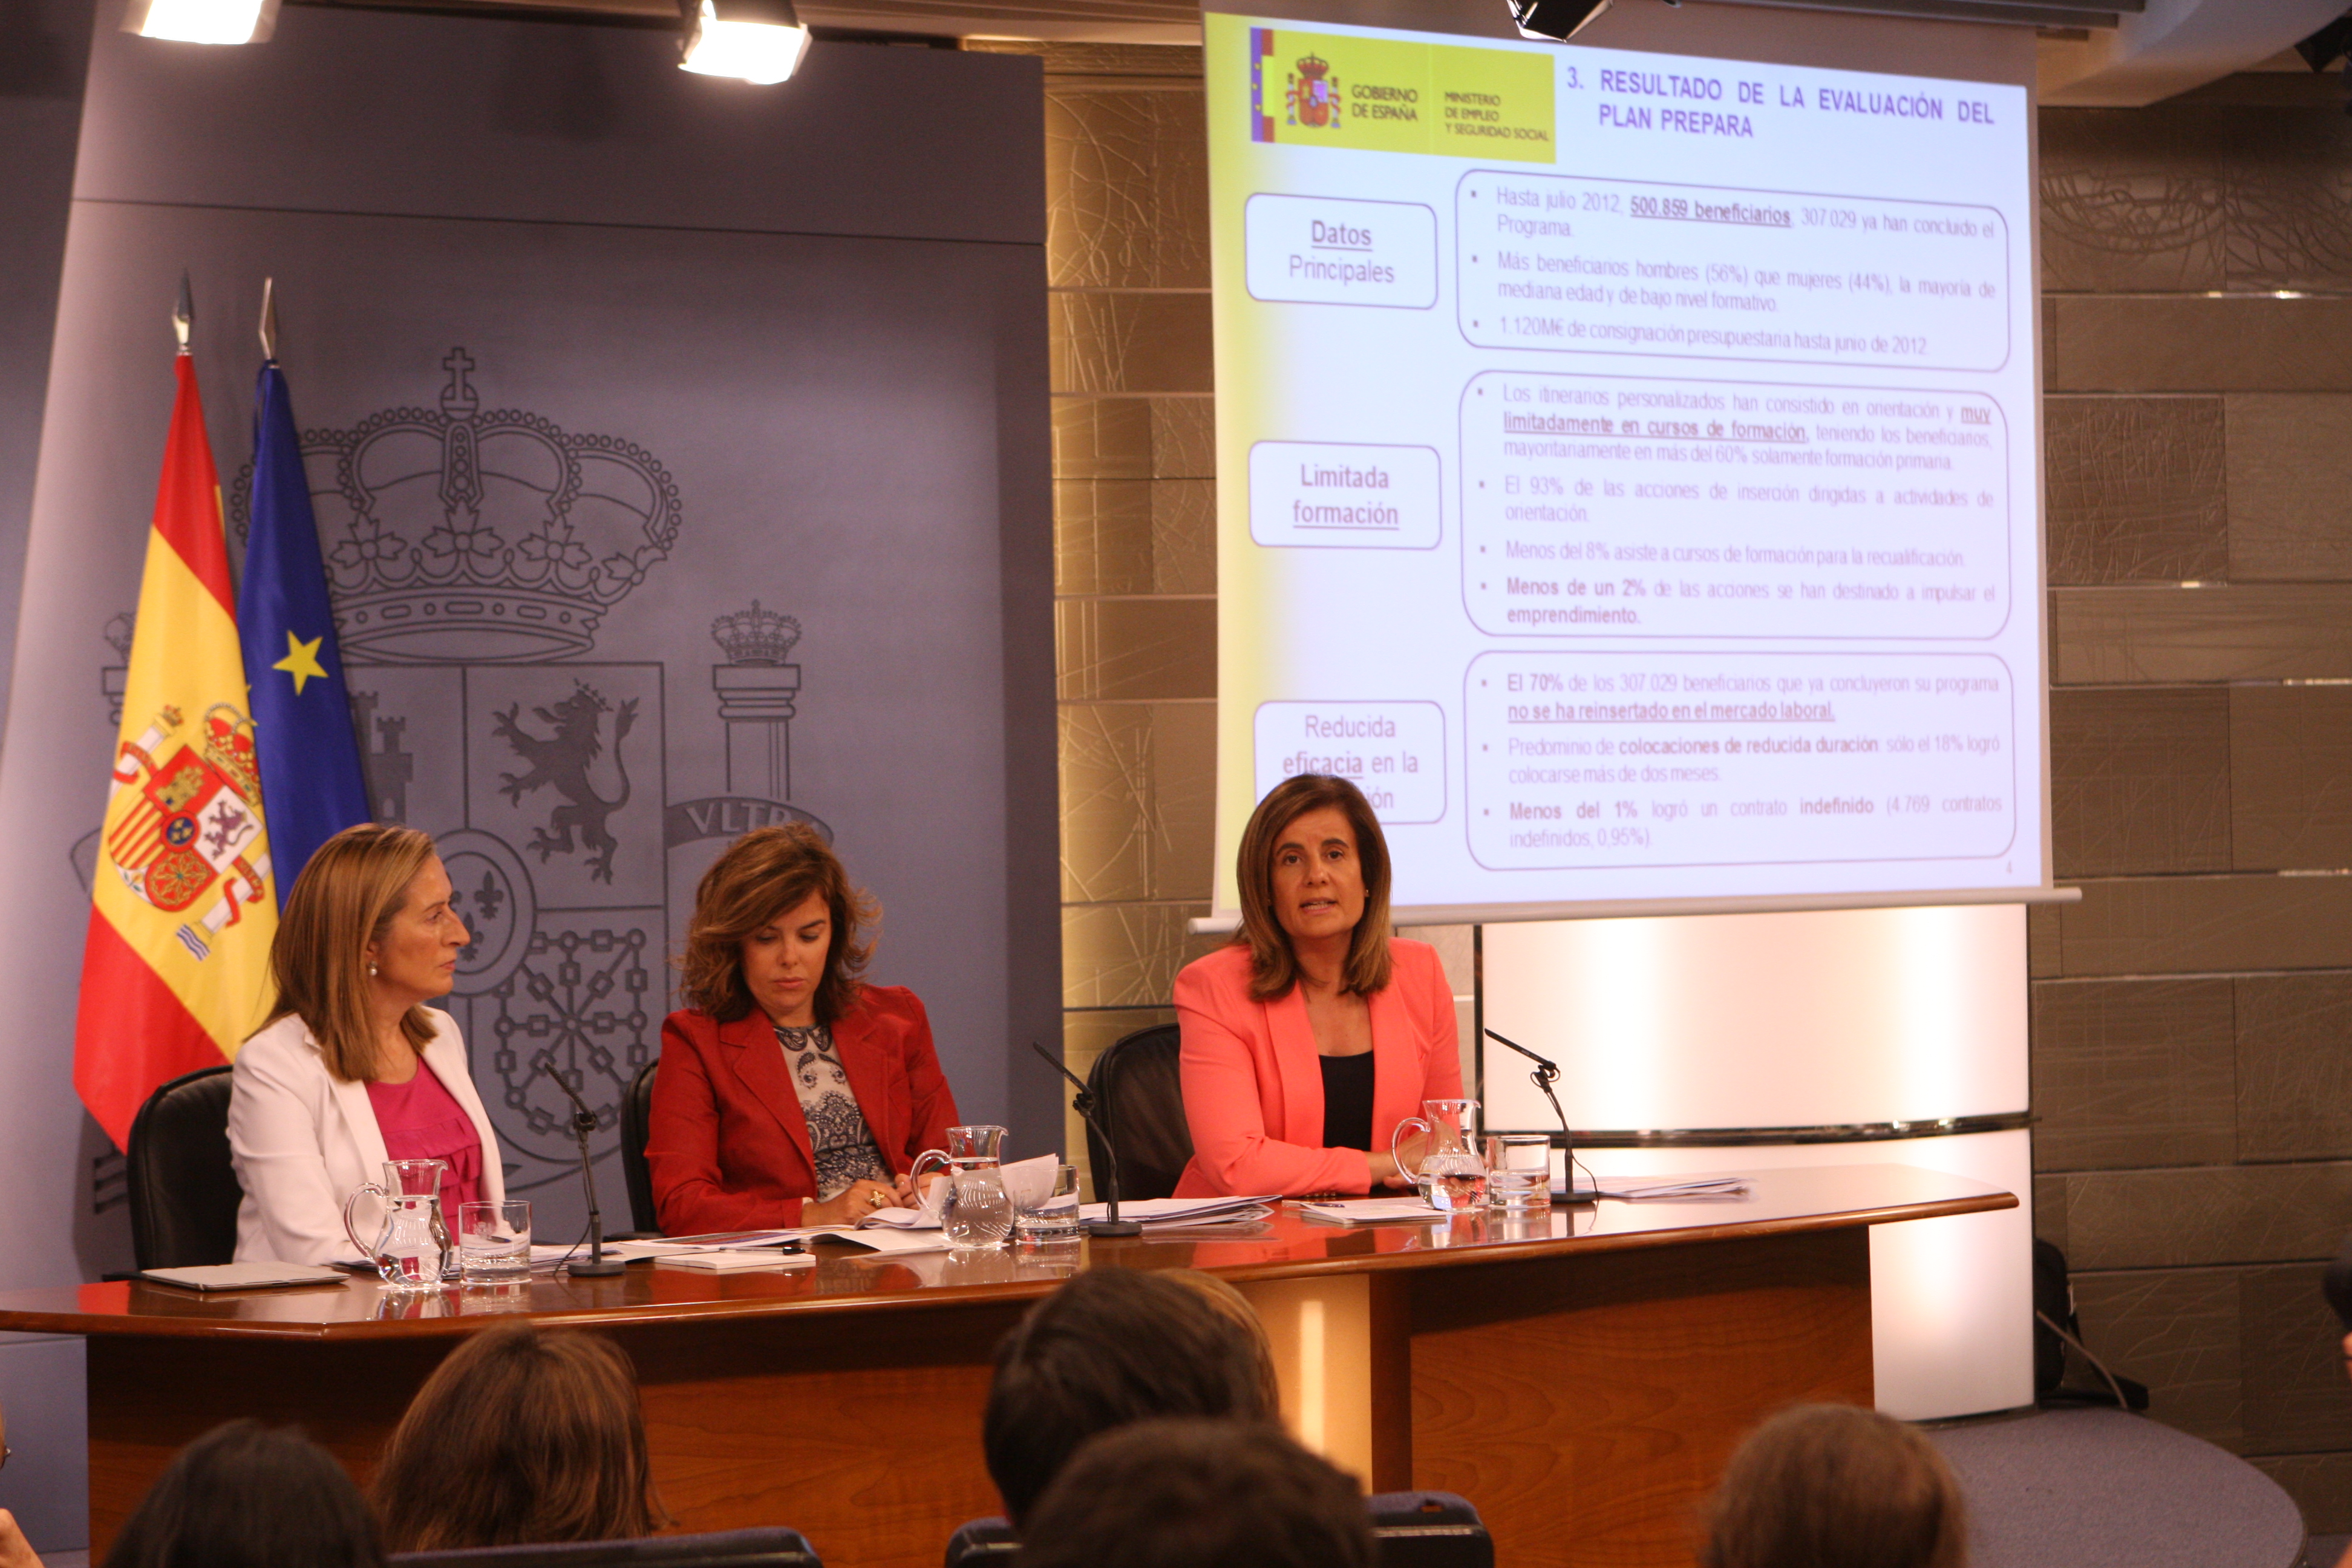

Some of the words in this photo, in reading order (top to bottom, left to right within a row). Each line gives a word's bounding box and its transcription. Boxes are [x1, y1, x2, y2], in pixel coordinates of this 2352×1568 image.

[1351, 84, 1418, 103] GOBIERNO
[1445, 91, 1500, 106] MINISTERIO
[1567, 67, 1584, 90] 3.
[1601, 69, 1722, 100] RESULTADO
[1738, 82, 1764, 104] DE
[1780, 85, 1805, 109] LA
[1819, 88, 1943, 119] EVALUACIÓN
[1958, 100, 1994, 123] DEL
[1352, 103, 1368, 118] DE
[1372, 103, 1417, 121] ESPAÑA
[1445, 107, 1457, 119] DE
[1460, 108, 1499, 121] EMPLEO
[1599, 104, 1651, 129] PLAN
[1662, 111, 1753, 137] PREPARA
[1454, 124, 1511, 139] SEGURIDAD
[1513, 128, 1549, 142] SOCIAL
[1497, 186, 1540, 207] Hasta
[1546, 189, 1576, 212] julio
[1631, 195, 1688, 216] 500.859
[1862, 215, 1877, 234] ya
[1883, 214, 1907, 232] han
[1914, 217, 1978, 237] concluido
[1983, 221, 1994, 239] el
[1311, 220, 1372, 246] Datos
[1497, 214, 1575, 239] Programa.
[1289, 255, 1394, 285] Principales
[1498, 250, 1529, 270] Más
[1537, 253, 1628, 276] beneficiarios
[1636, 260, 1699, 281] hombres
[1706, 263, 1748, 286] (56%)
[1755, 269, 1780, 289] que
[1788, 271, 1841, 292] mujeres
[1900, 276, 1911, 293] la
[1979, 282, 1995, 299] de
[1498, 281, 1562, 300] mediana
[1566, 284, 1604, 302] edad
[1619, 287, 1637, 304] de
[1641, 288, 1671, 309] bajo
[1676, 290, 1708, 307] nivel
[1567, 319, 1586, 338] de
[1590, 321, 1685, 345] consignación
[1688, 327, 1791, 348] presupuestaria
[1794, 332, 1831, 351] hasta
[1835, 334, 1866, 354] junio
[1871, 336, 1888, 353] de
[1504, 384, 1530, 403] Los
[1540, 385, 1609, 406] itinerarios
[1618, 388, 1725, 410] personalizados
[1733, 394, 1758, 411] han
[1766, 396, 1834, 414] consistido
[1843, 400, 1858, 416] en
[1867, 399, 1939, 419] orientación
[1961, 405, 1991, 424] muy
[1504, 411, 1613, 432] limitadamente
[1622, 421, 1639, 434] en
[1647, 421, 1698, 436] cursos
[1707, 420, 1724, 437] de
[1816, 424, 1874, 442] teniendo
[1881, 426, 1900, 443] los
[1504, 440, 1631, 461] mayoritariamente
[1635, 445, 1651, 461] en
[1657, 445, 1687, 462] más
[1691, 445, 1713, 462] del
[1716, 445, 1747, 463] 60%
[1752, 447, 1822, 467] solamente
[1825, 448, 1893, 468] formación
[1300, 463, 1390, 489] Limitada
[1506, 475, 1520, 494] El
[1530, 477, 1563, 495] 93%
[1575, 479, 1593, 497] de
[1604, 479, 1624, 497] las
[1635, 482, 1699, 499] acciones
[1710, 481, 1727, 500] de
[1737, 484, 1799, 502] inserción
[1809, 485, 1866, 507] dirigidas
[1894, 486, 1968, 506] actividades
[1978, 490, 1994, 507] de
[1293, 500, 1399, 526] formación
[1507, 540, 1555, 560] Menos
[1560, 542, 1583, 560] del
[1586, 542, 1610, 560] 8%
[1615, 544, 1658, 561] asiste
[1673, 547, 1720, 562] cursos
[1724, 545, 1742, 563] de
[1746, 545, 1814, 564] formación
[1817, 549, 1847, 567] para
[1852, 547, 1863, 565] la
[1508, 577, 1559, 595] Menos
[1567, 578, 1586, 596] de
[1595, 583, 1615, 596] un
[1622, 578, 1646, 596] 2%
[1655, 579, 1672, 598] de
[1679, 579, 1700, 598] las
[1708, 581, 1769, 599] acciones
[1777, 585, 1793, 599] se
[1801, 581, 1825, 599] han
[1833, 581, 1899, 601] destinado
[1922, 583, 1976, 604] impulsar
[1508, 604, 1642, 627] emprendimiento.
[1508, 673, 1522, 691] El
[1530, 673, 1564, 691] 70%
[1569, 674, 1587, 691] de
[1593, 674, 1614, 691] los
[1619, 673, 1677, 691] 307.029
[1684, 672, 1771, 691] beneficiarios
[1777, 678, 1803, 695] que
[1808, 678, 1824, 695] ya
[1830, 674, 1910, 696] concluyeron
[1915, 678, 1930, 691] su
[1936, 678, 1999, 696] programa
[1509, 705, 1528, 719] no
[1533, 706, 1550, 719] se
[1556, 702, 1575, 719] ha
[1579, 701, 1668, 719] reinsertado
[1672, 705, 1691, 718] en
[1694, 702, 1707, 718] el
[1711, 701, 1777, 718] mercado
[1781, 701, 1835, 718] laboral.
[1305, 714, 1396, 737] Reducida
[1509, 737, 1592, 756] Predominio
[1596, 737, 1615, 756] de
[1619, 737, 1720, 755] colocaciones
[1725, 737, 1742, 754] de
[1746, 737, 1812, 753] reducida
[1918, 736, 1930, 752] el
[1935, 735, 1964, 752] 18%
[1967, 735, 1999, 756] logró
[1282, 751, 1362, 774] eficacia
[1371, 756, 1394, 773] en
[1403, 750, 1418, 773] la
[1509, 765, 1581, 784] colocarse
[1584, 765, 1615, 783] más
[1618, 765, 1636, 782] de
[1641, 765, 1668, 782] dos
[1671, 766, 1722, 782] meses.
[685, 801, 819, 835] VLTR
[1510, 802, 1562, 820] Menos
[1576, 800, 1600, 818] del
[1614, 800, 1638, 818] 1%
[1651, 799, 1688, 822] logró
[1701, 803, 1717, 817] un
[1731, 799, 1787, 815] contrato
[1800, 797, 1875, 814] indefinido
[1942, 796, 2002, 812] contratos
